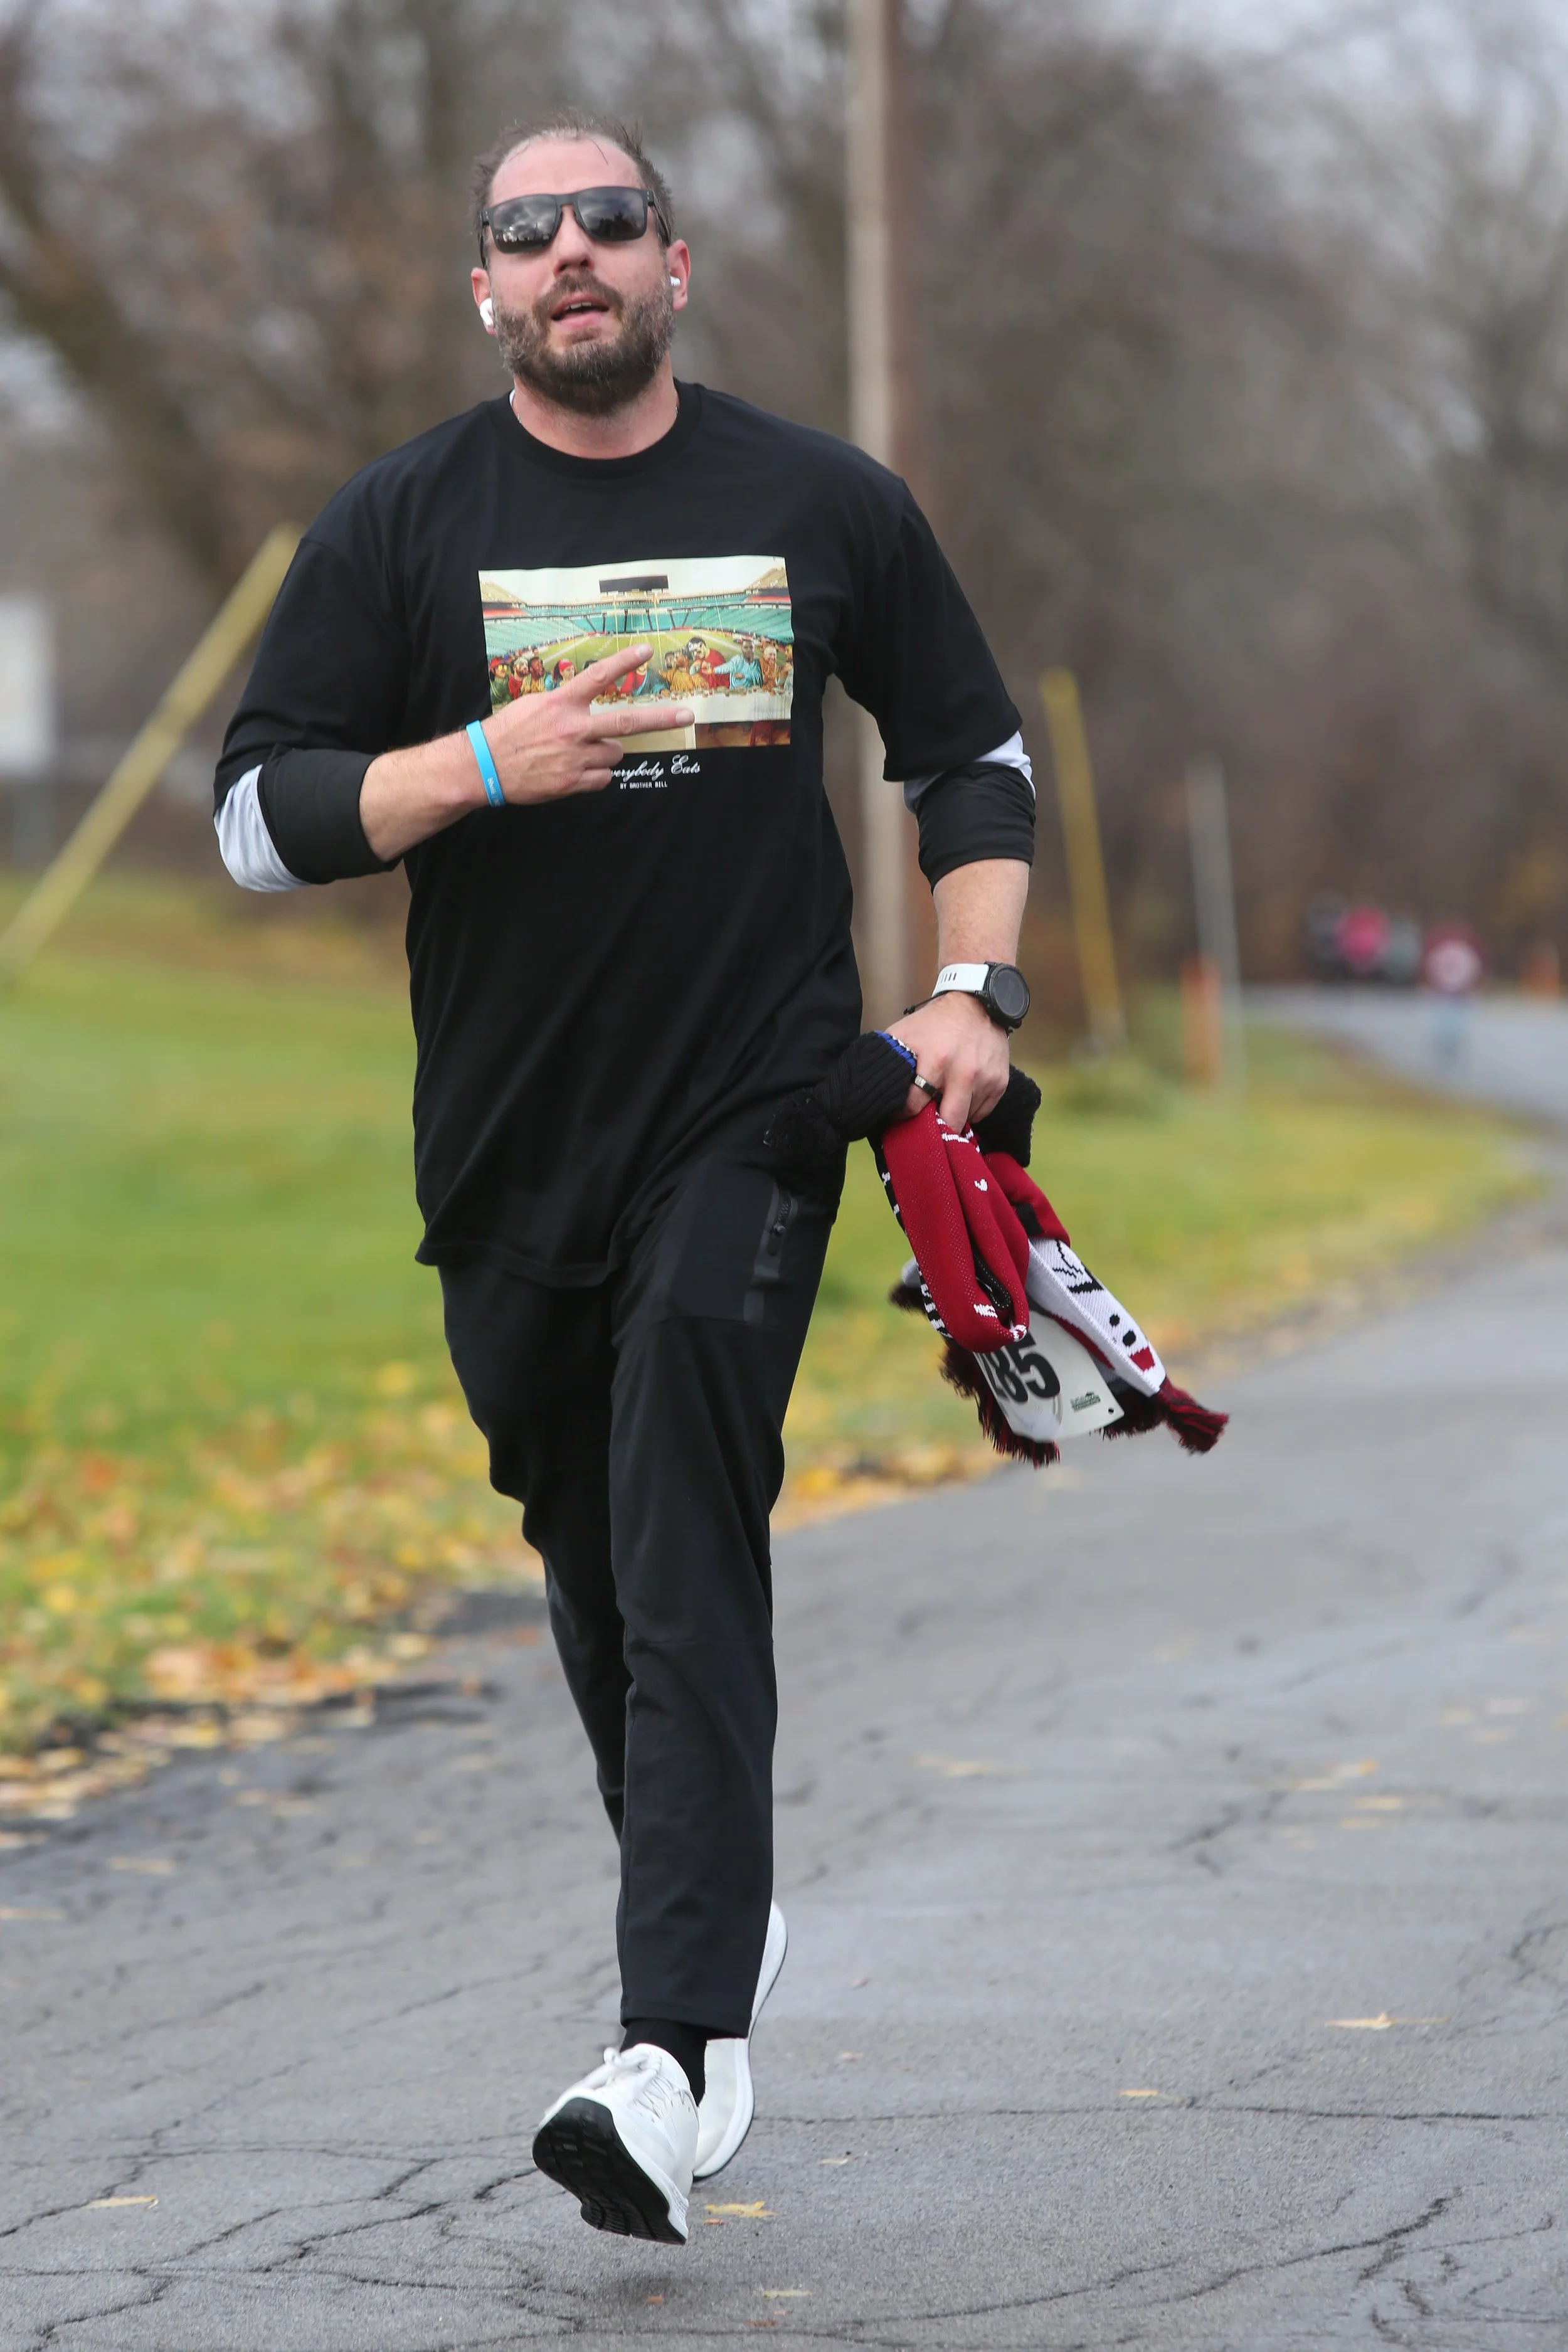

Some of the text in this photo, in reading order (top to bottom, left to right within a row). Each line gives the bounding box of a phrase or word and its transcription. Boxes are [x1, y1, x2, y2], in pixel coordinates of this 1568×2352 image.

[611, 754, 701, 782] verybody Eats
[629, 781, 653, 789] BROTHER
[655, 780, 668, 788] BILL
